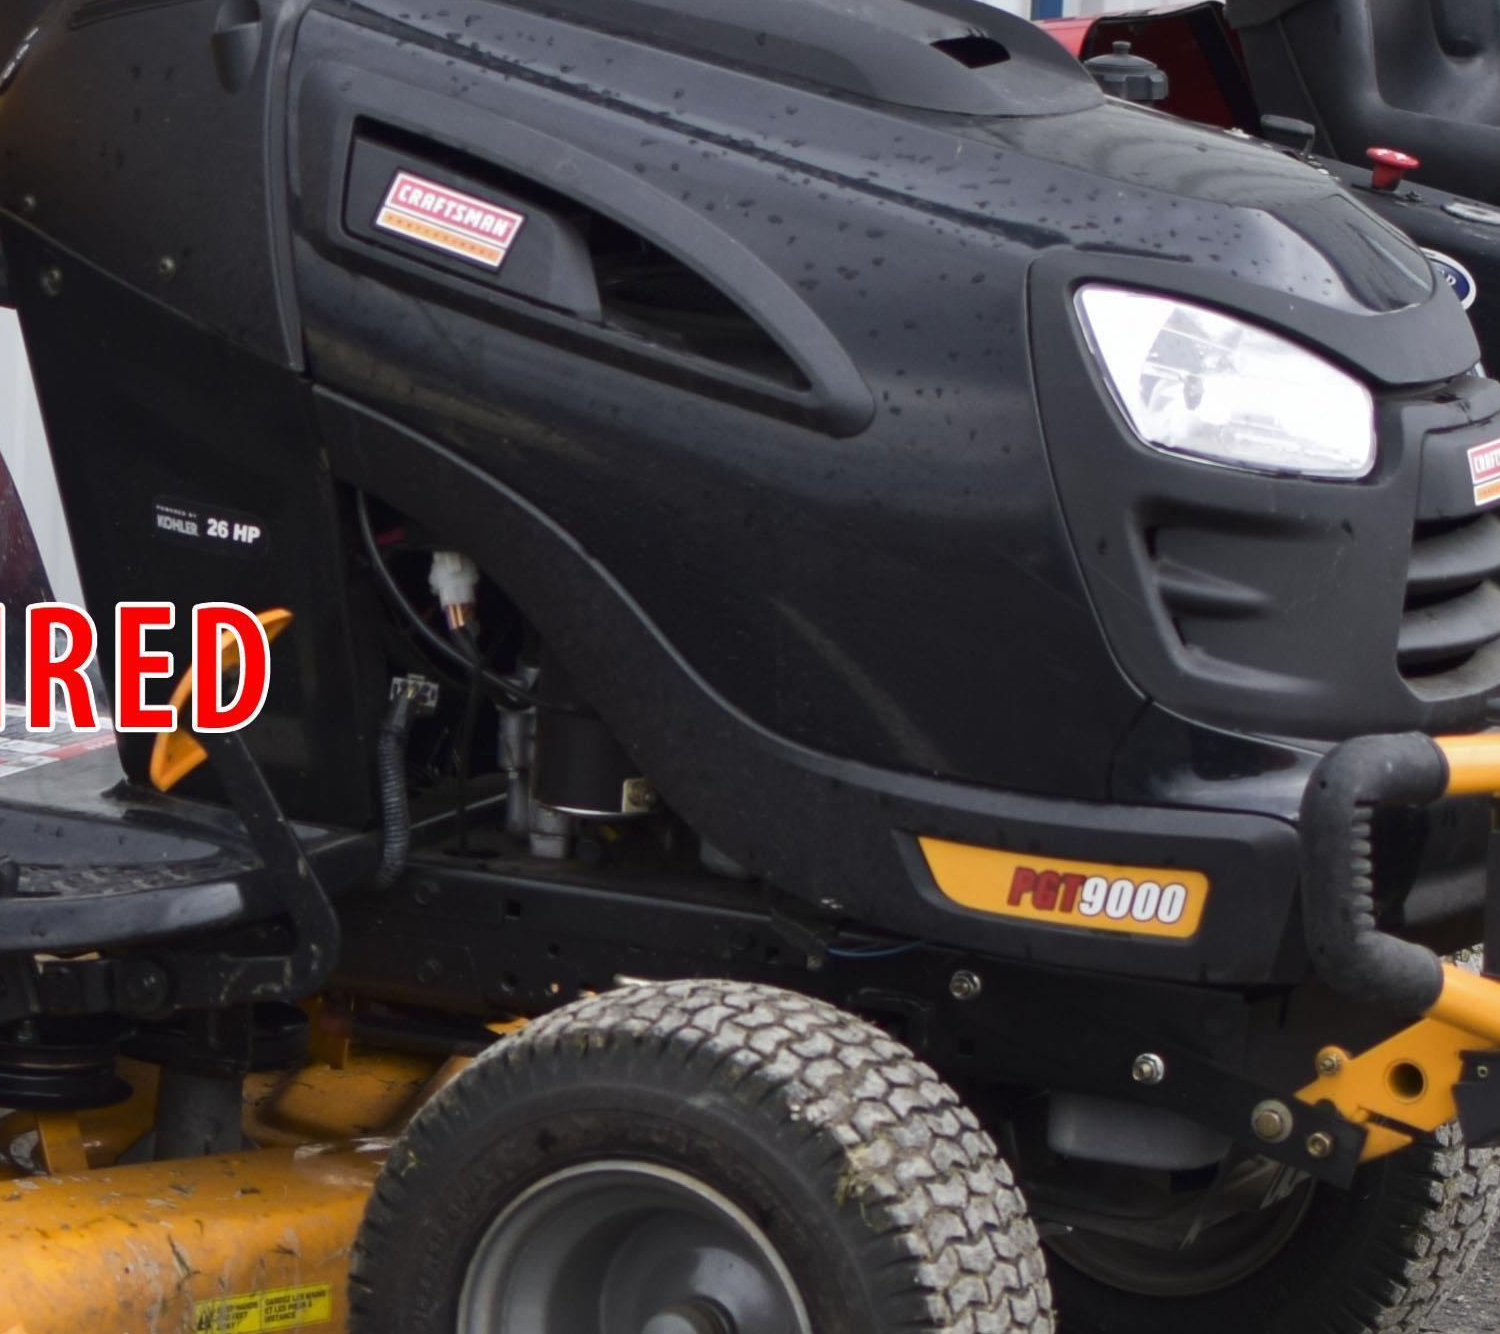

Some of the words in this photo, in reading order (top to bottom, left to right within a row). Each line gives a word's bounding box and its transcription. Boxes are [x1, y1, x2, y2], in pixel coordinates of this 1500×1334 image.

[397, 183, 511, 238] CRAFTSMAN
[206, 517, 230, 539] 26
[232, 522, 261, 544] HP
[1006, 865, 1188, 925] PGT9000
